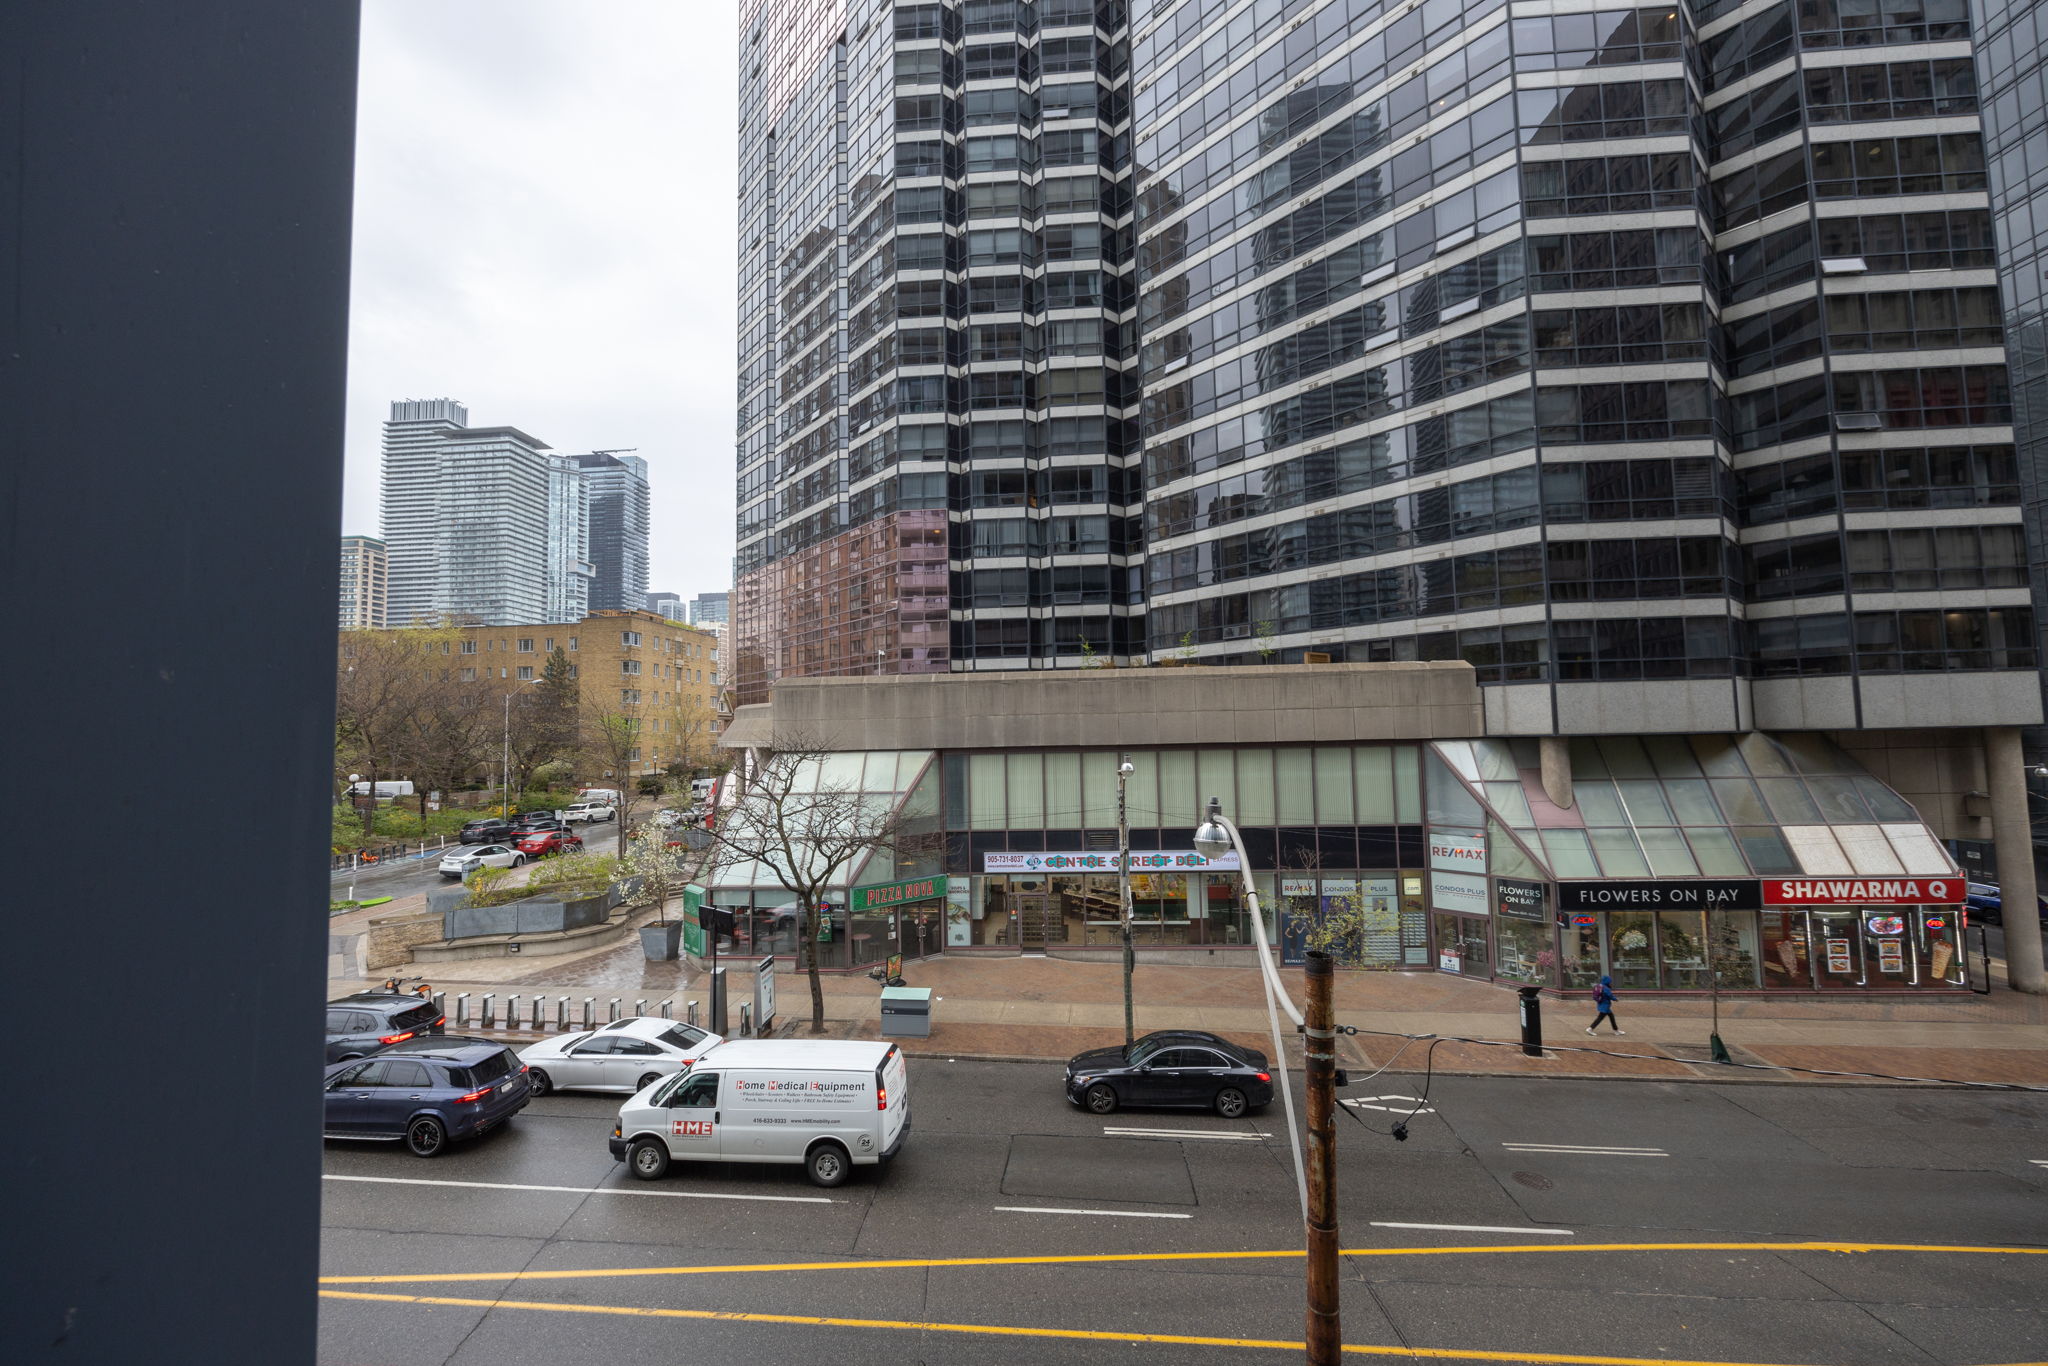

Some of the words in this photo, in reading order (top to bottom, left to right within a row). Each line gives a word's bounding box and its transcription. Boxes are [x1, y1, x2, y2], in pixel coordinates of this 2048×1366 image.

[987, 855, 1024, 863] 905-731-8037
[1432, 846, 1484, 860] RE/MAX
[1045, 856, 1106, 868] CENTRE
[1111, 855, 1170, 867] SREET
[1175, 855, 1210, 866] DELI
[867, 886, 903, 906] PIZZA
[905, 880, 934, 899] NOVA
[1434, 884, 1466, 893] CONDOS
[1467, 888, 1486, 896] PLUS
[1499, 886, 1541, 898] FLOWERS
[1580, 889, 1661, 903] FLOWERS
[1669, 889, 1698, 902] ON
[1706, 888, 1739, 902] BAY
[1781, 881, 1921, 898] SHAWARMA
[1928, 880, 1948, 899] Q
[1520, 897, 1535, 905] BAY
[736, 1080, 766, 1090] Home
[768, 1080, 808, 1091] Medical
[810, 1081, 865, 1092] Equipment
[672, 1121, 712, 1135] HME
